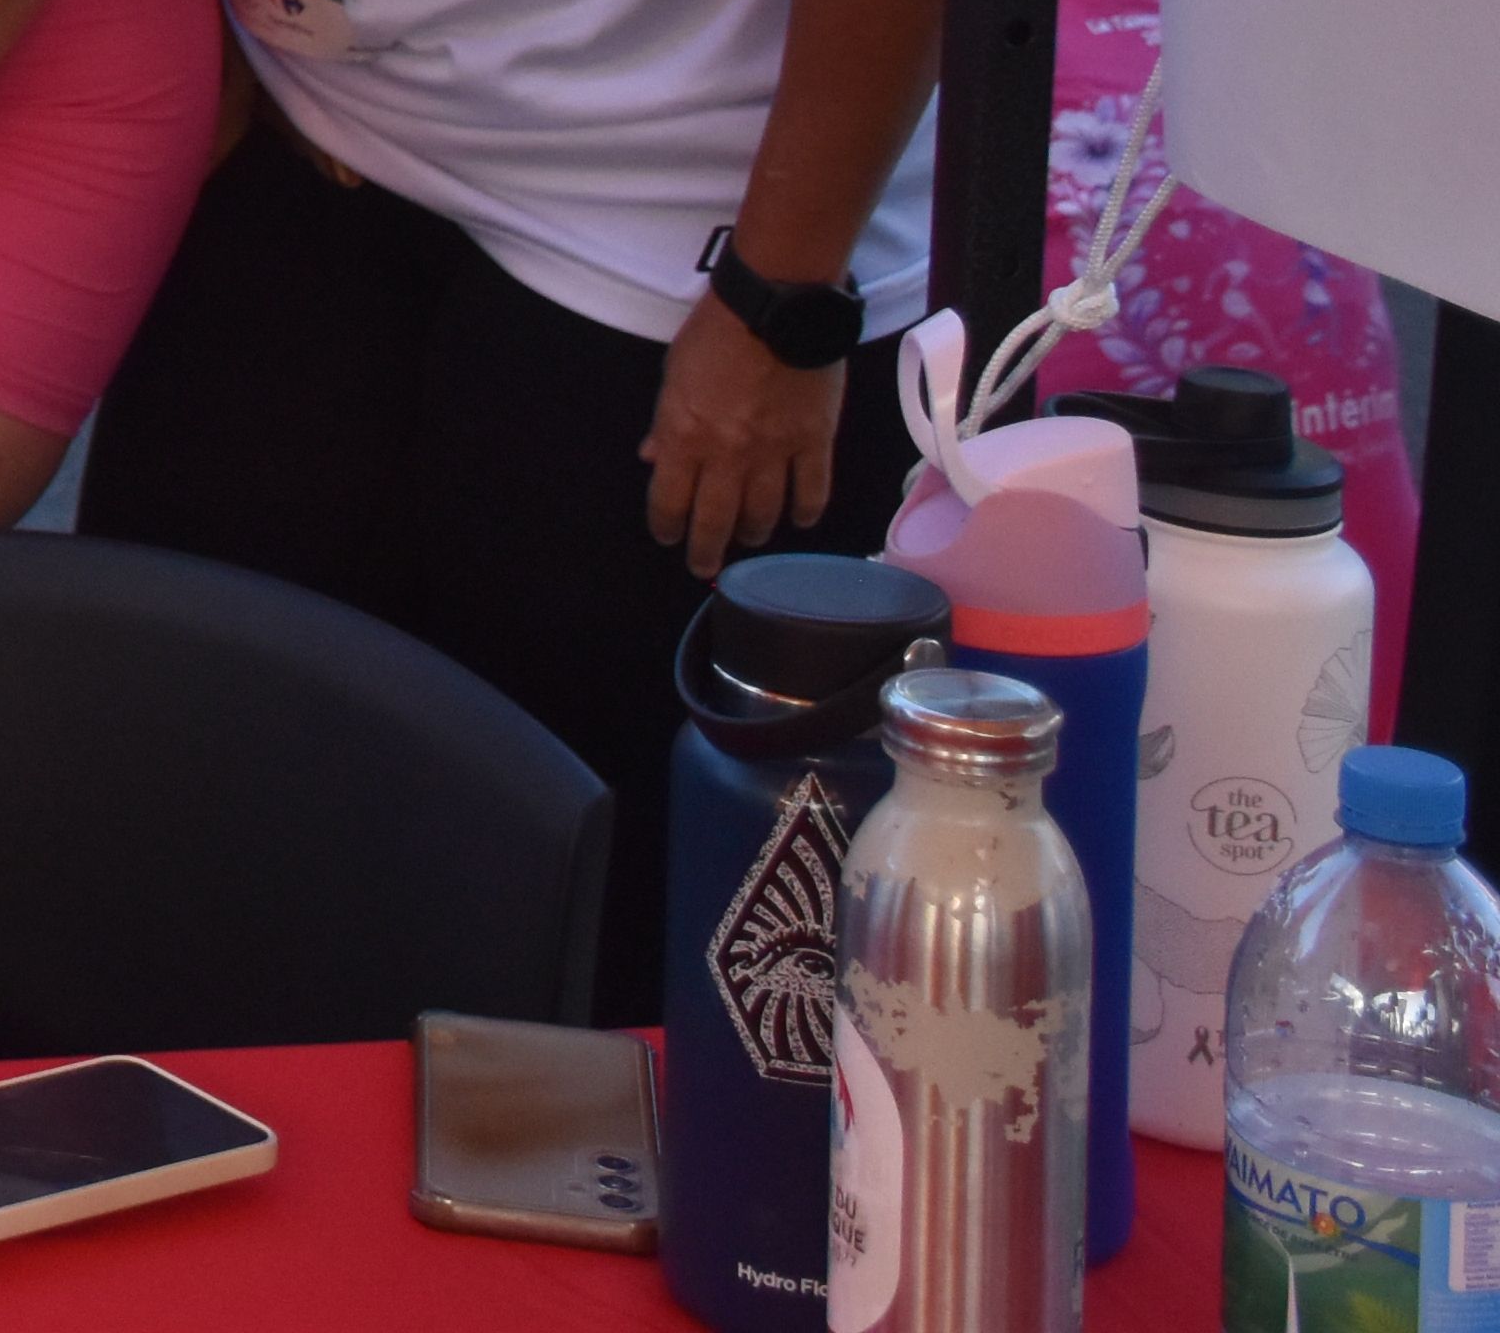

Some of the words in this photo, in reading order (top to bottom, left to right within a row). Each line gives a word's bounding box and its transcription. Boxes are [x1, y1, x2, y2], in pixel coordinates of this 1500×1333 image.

[1228, 788, 1263, 809] the
[1207, 804, 1280, 843] tea
[1219, 843, 1264, 863] spot
[738, 1262, 797, 1291] Hydro
